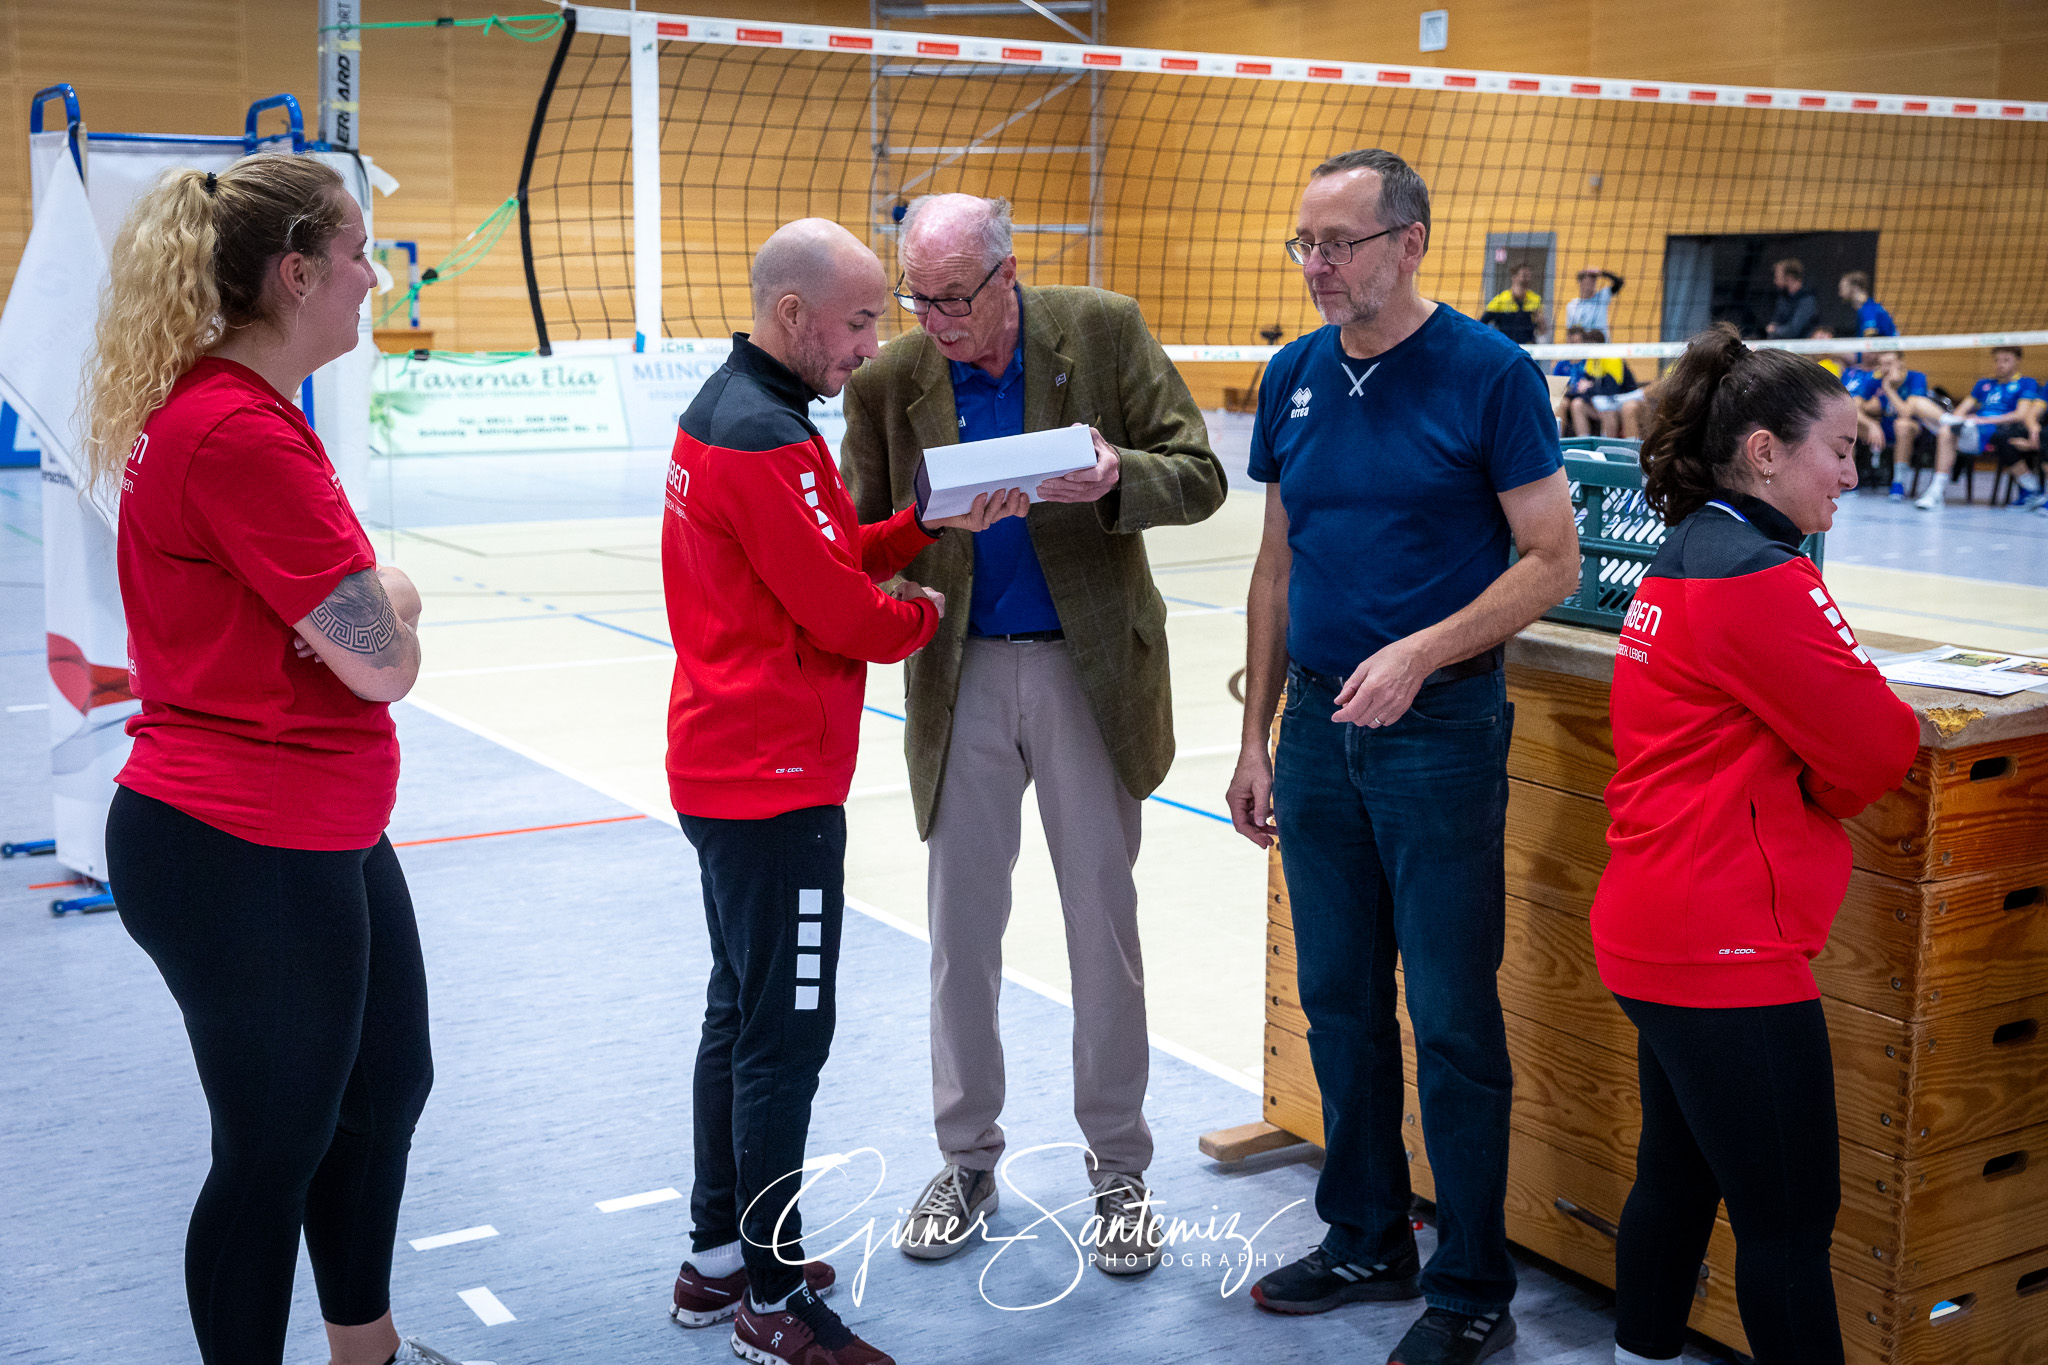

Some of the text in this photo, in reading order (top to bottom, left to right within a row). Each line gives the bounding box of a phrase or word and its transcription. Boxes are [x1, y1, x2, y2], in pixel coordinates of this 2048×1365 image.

[337, 0, 353, 145] ERARD PORT
[407, 364, 604, 389] Taverna Elia
